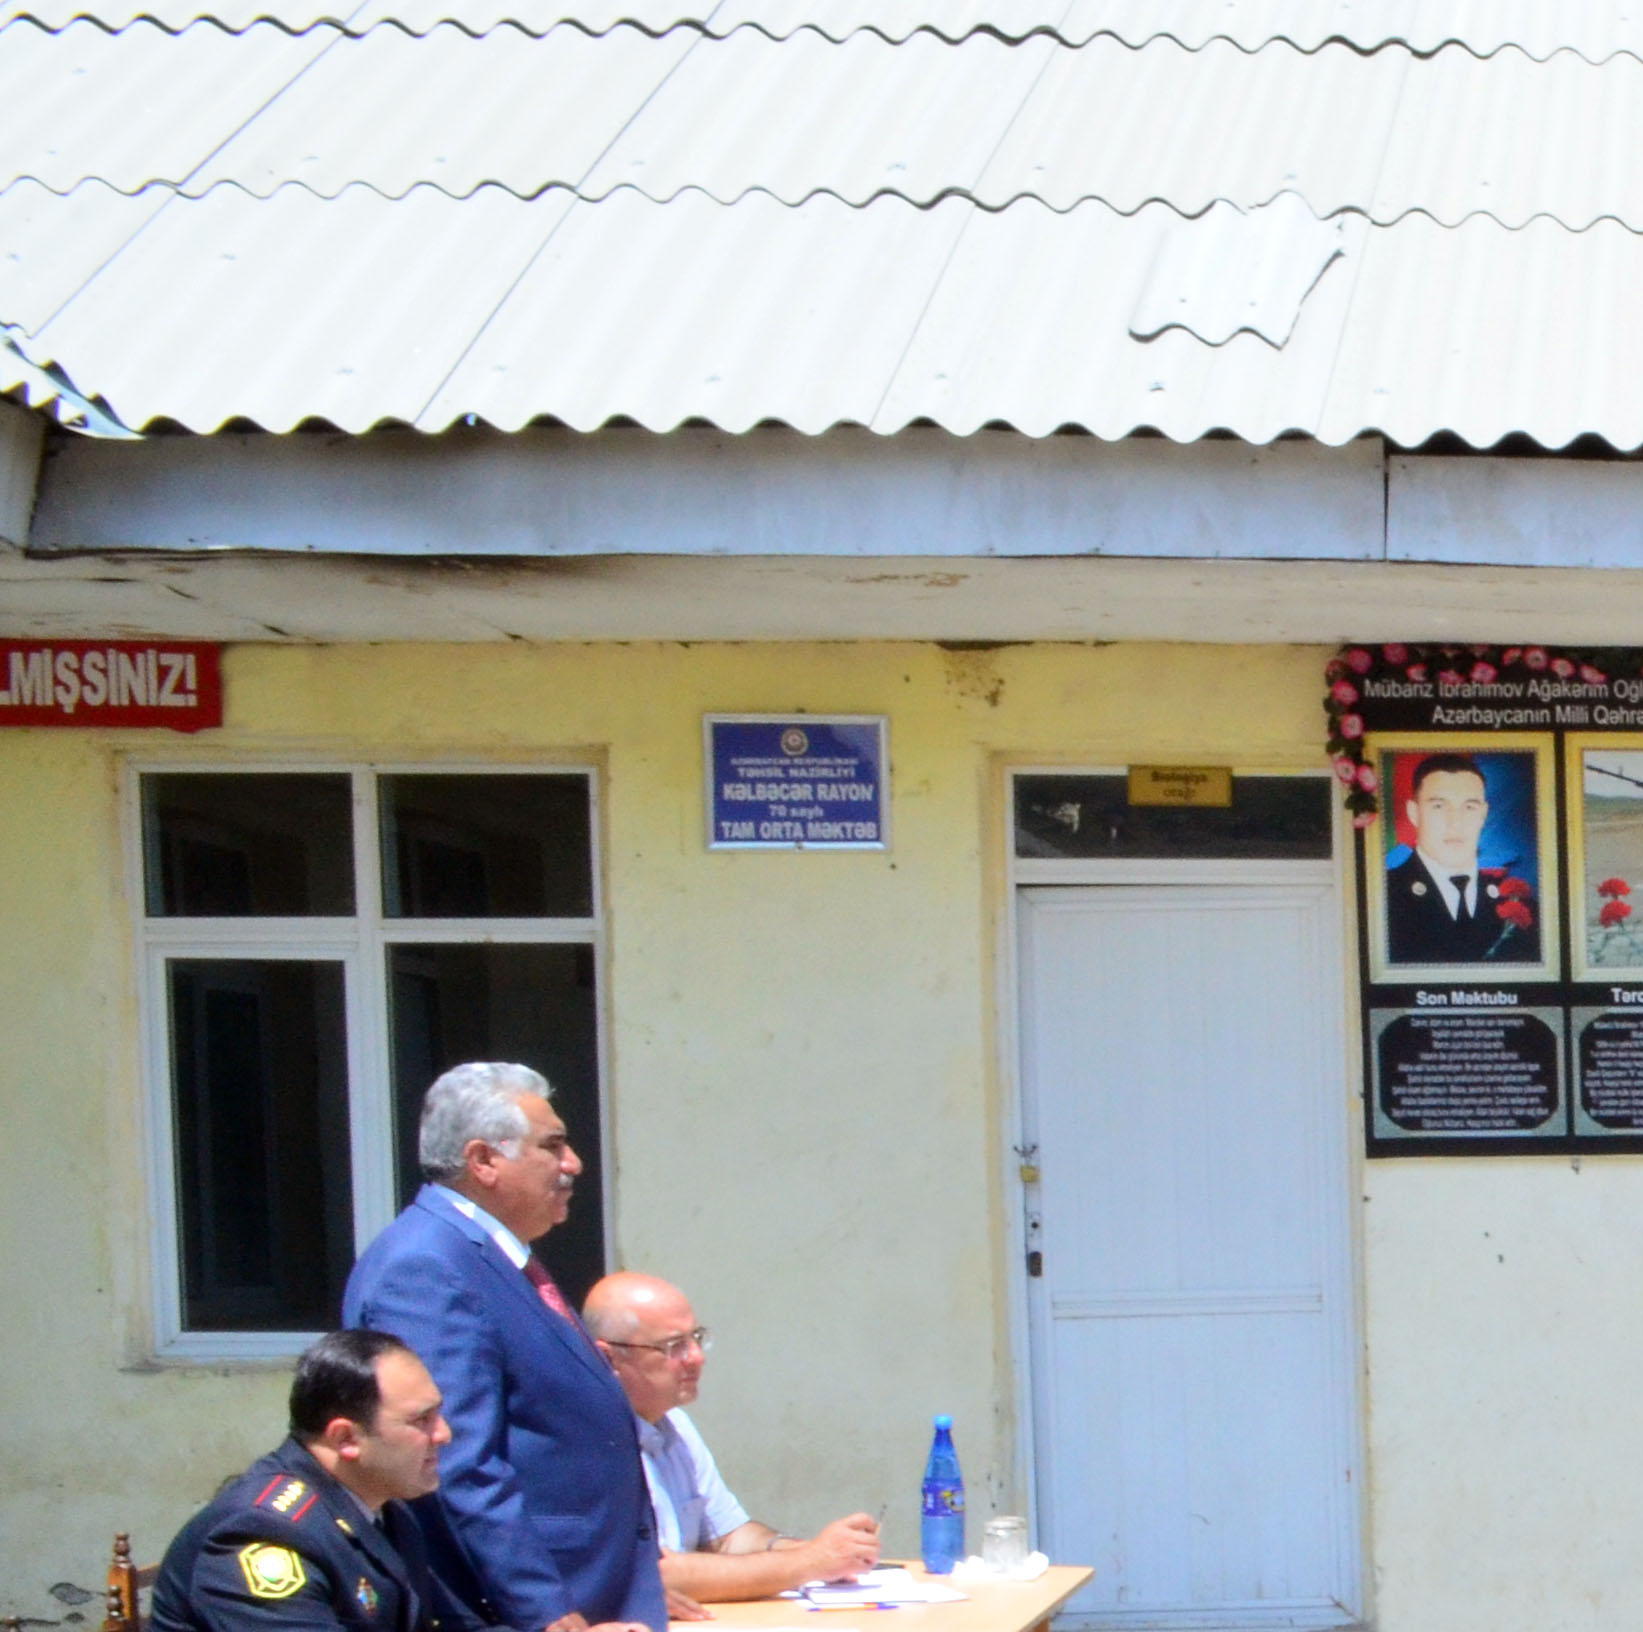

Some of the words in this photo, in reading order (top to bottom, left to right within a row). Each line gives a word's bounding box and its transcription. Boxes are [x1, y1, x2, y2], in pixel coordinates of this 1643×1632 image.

[1432, 704, 1551, 729] Azərbaycanın
[1555, 704, 1589, 723] Milli
[737, 766, 785, 778] TƏHSİL
[788, 766, 856, 778] NAZİRLİYİ
[722, 783, 814, 801] KƏLBƏCƏR
[816, 783, 875, 801] RAYON
[720, 820, 756, 839] TAM
[759, 820, 804, 839] ORTA
[807, 820, 878, 839] MƏKTƏB
[1416, 991, 1448, 1006] Son
[1451, 990, 1519, 1006] Məktubu
